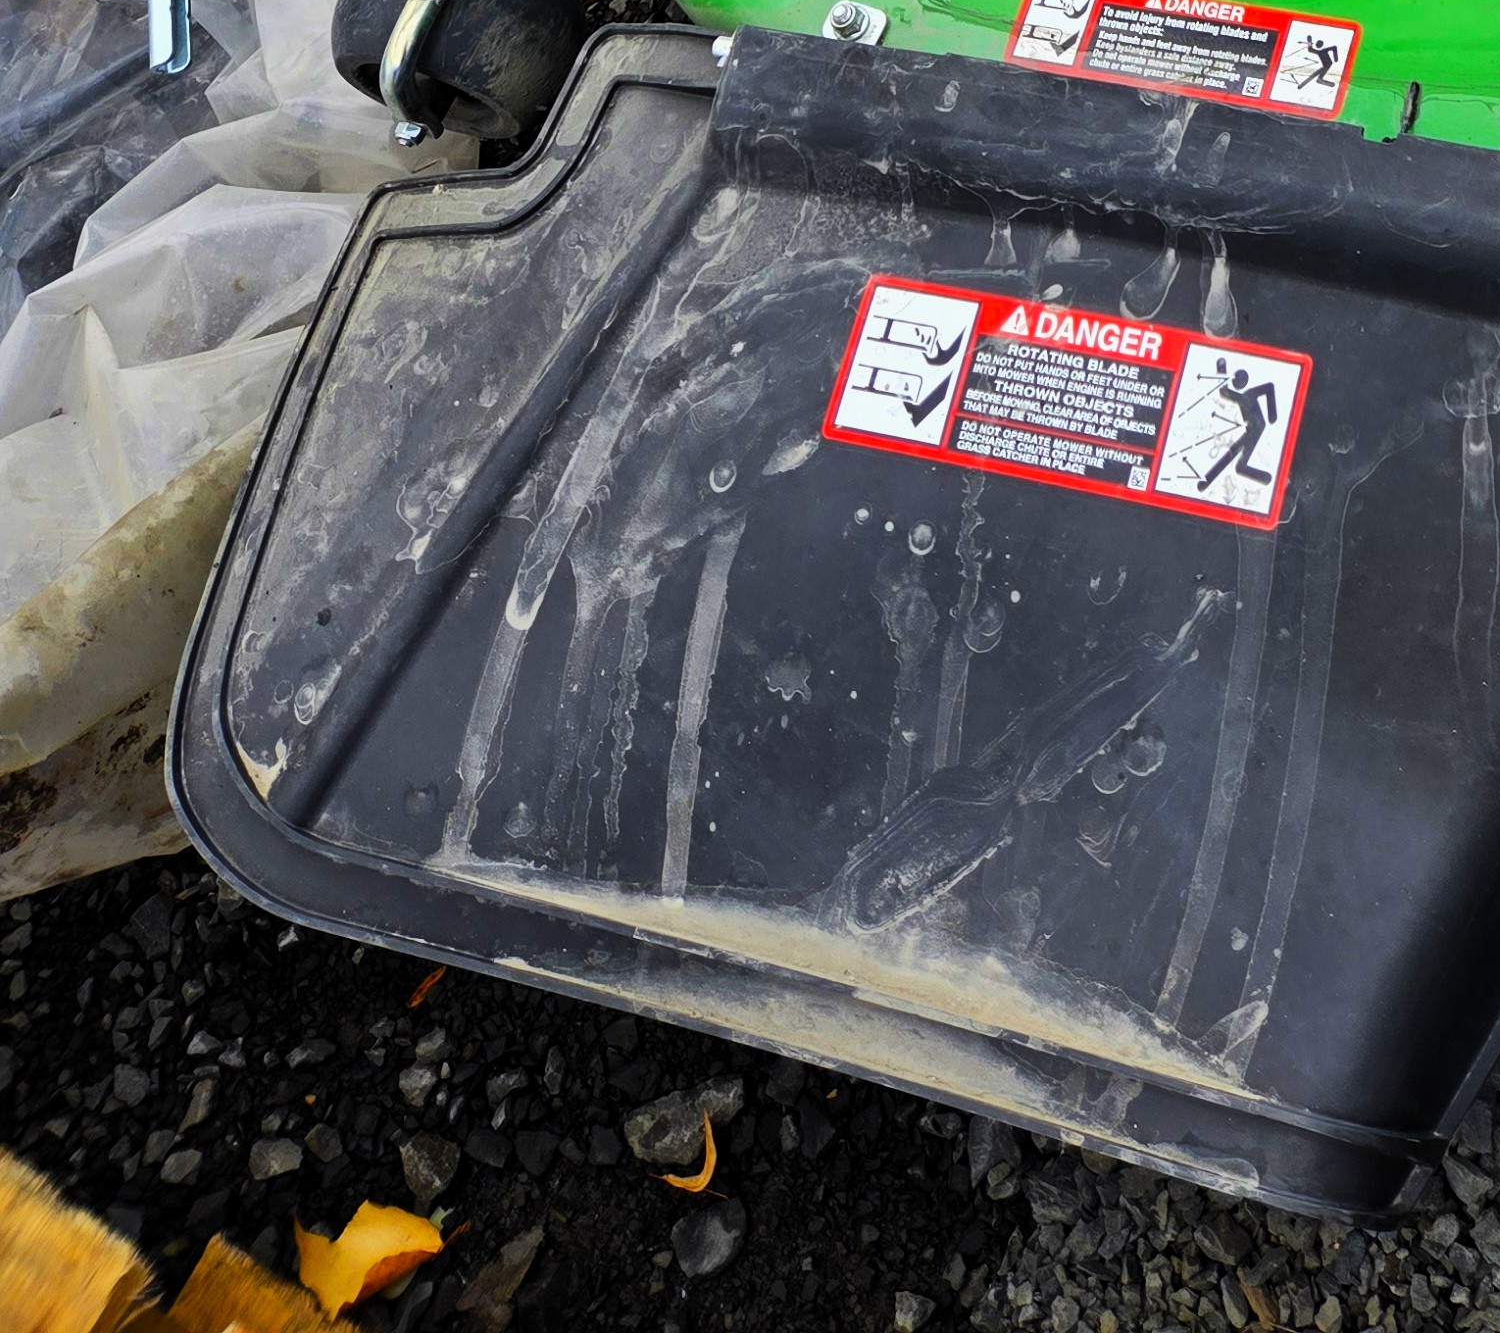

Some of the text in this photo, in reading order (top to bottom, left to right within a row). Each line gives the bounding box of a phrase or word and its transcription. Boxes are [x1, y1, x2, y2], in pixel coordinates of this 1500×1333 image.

[1099, 16, 1164, 38] thrown objects:
[1103, 6, 1268, 42] To avoid injury from rotating blades and
[1092, 48, 1104, 58] Do
[1104, 50, 1117, 60] not
[1117, 52, 1145, 67] operate
[1146, 57, 1172, 69] mower
[1173, 62, 1202, 75] without
[1095, 39, 1114, 52] Keep
[1115, 42, 1156, 59] bystanders
[1163, 50, 1179, 61] safe
[1180, 53, 1212, 67] distance
[1098, 30, 1268, 66] Keep hands and feet away from rotating blades.
[1089, 58, 1110, 68] chute
[1111, 61, 1119, 70] or
[1120, 63, 1142, 74] entire
[1143, 67, 1164, 79] grass
[1202, 77, 1227, 90] place.
[1035, 311, 1162, 360] DANGER
[975, 352, 1166, 397] DO NOT PUT HANDS OR FEET UNDER OR
[1006, 342, 1140, 379] ROTATING BLADE
[972, 362, 1163, 409] INTO MOWER WHEN ENGINE IS RUNNING
[992, 379, 1135, 418] THROWN OBJECTS
[962, 399, 1118, 440] THAT MAY BE THROWN BY BLADE
[965, 387, 1157, 435] BEFORE MOWING, CLEAR AREA OF OBJECTS
[955, 439, 1086, 475] GRASS CATCHER IN PLACE
[958, 430, 1105, 468] DISCHARGE CHUTE OR ENTIRE
[960, 420, 1144, 466] DO NOT OPERATE MOWER WITHOUT
